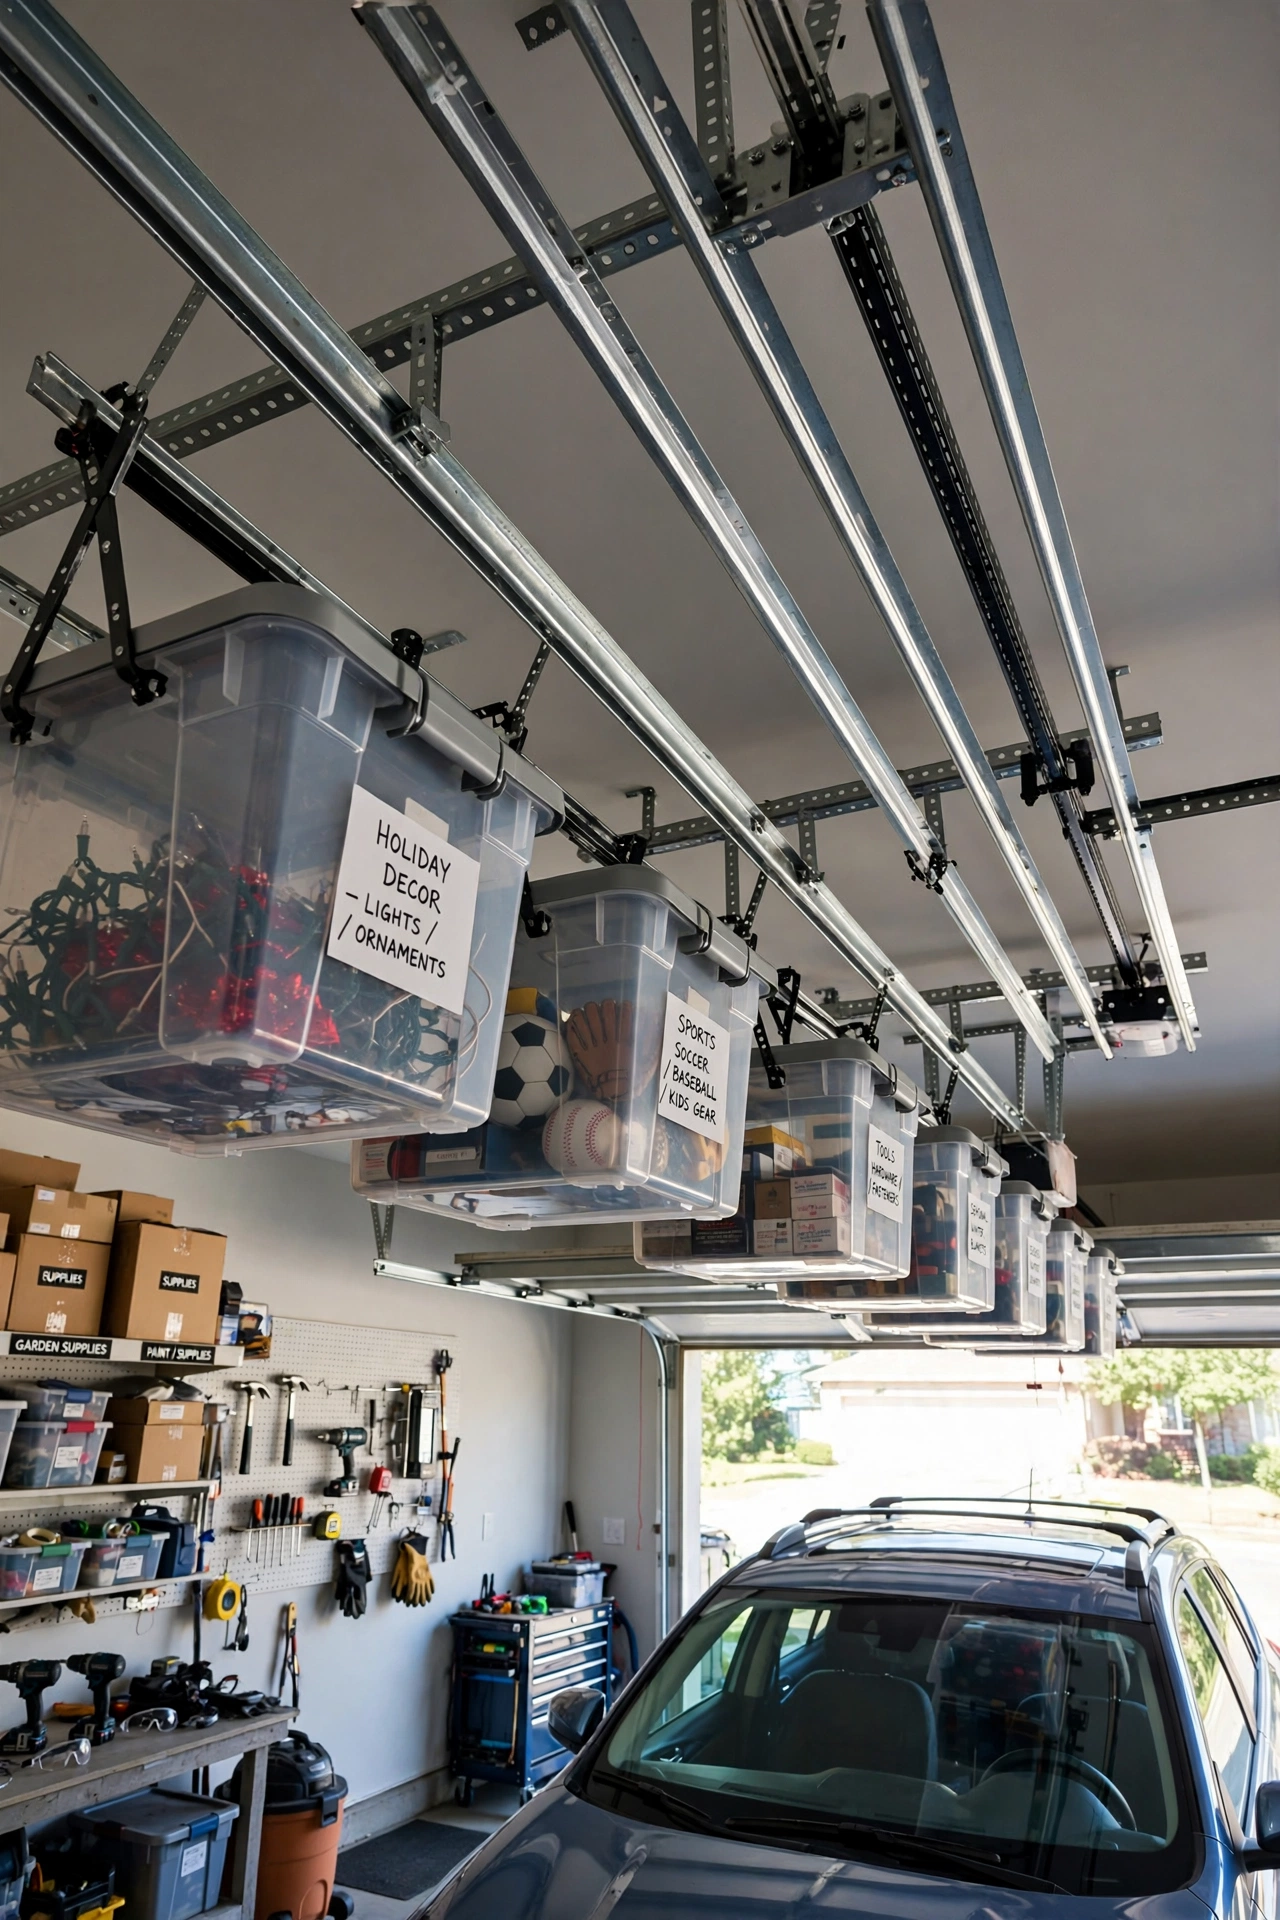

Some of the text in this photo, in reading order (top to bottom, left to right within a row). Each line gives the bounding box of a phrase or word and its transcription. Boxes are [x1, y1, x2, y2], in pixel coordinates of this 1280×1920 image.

[376, 819, 451, 883] HOLIDAY
[383, 862, 441, 914] DECOR
[364, 893, 420, 935] LIGHTS
[355, 924, 446, 978] ORNAMENTS
[677, 1014, 716, 1050] SPORTS
[675, 1041, 710, 1074] SOCCER
[672, 1065, 717, 1101] BASEBALL
[669, 1088, 689, 1111] KIDS
[693, 1102, 717, 1125] GEAR
[876, 1140, 895, 1163] TOOLS
[162, 1275, 197, 1289] SUPPLIES
[15, 1339, 107, 1355] GARDEN SUPPLIES
